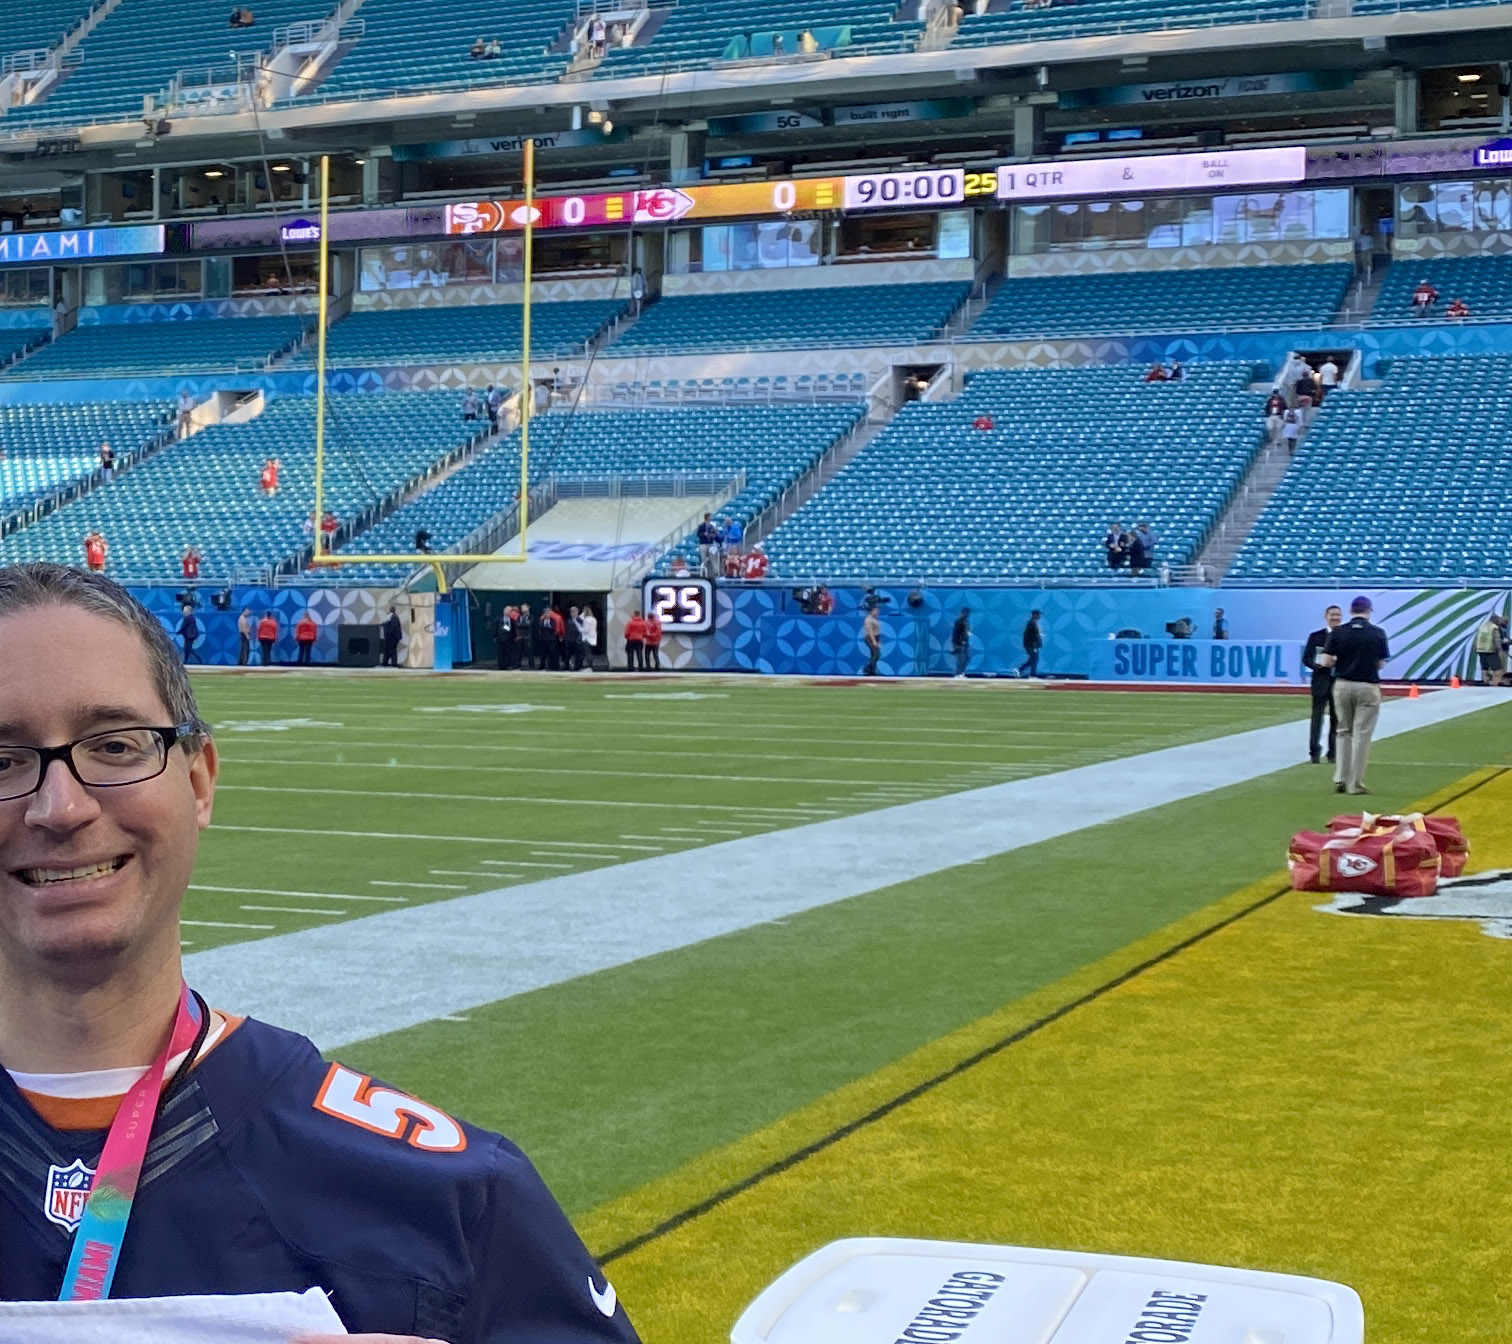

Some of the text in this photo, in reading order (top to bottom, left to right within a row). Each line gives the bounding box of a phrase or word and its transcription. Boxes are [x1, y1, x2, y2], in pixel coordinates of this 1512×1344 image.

[1141, 80, 1221, 101] verizon
[776, 113, 801, 130] 5G
[850, 109, 910, 120] built right
[489, 132, 555, 152] verion
[1202, 158, 1230, 170] BALL
[1208, 168, 1225, 179] ON
[856, 172, 998, 204] 90:00 25
[1006, 172, 1017, 191] 1
[1026, 169, 1064, 189] QTR
[563, 196, 587, 225] 0
[772, 181, 796, 210] 0
[655, 586, 702, 623] 25
[1114, 643, 1198, 676] SUPER
[1210, 646, 1288, 679] BOWL
[124, 1079, 149, 1142] SUPER
[312, 1060, 469, 1155] 5
